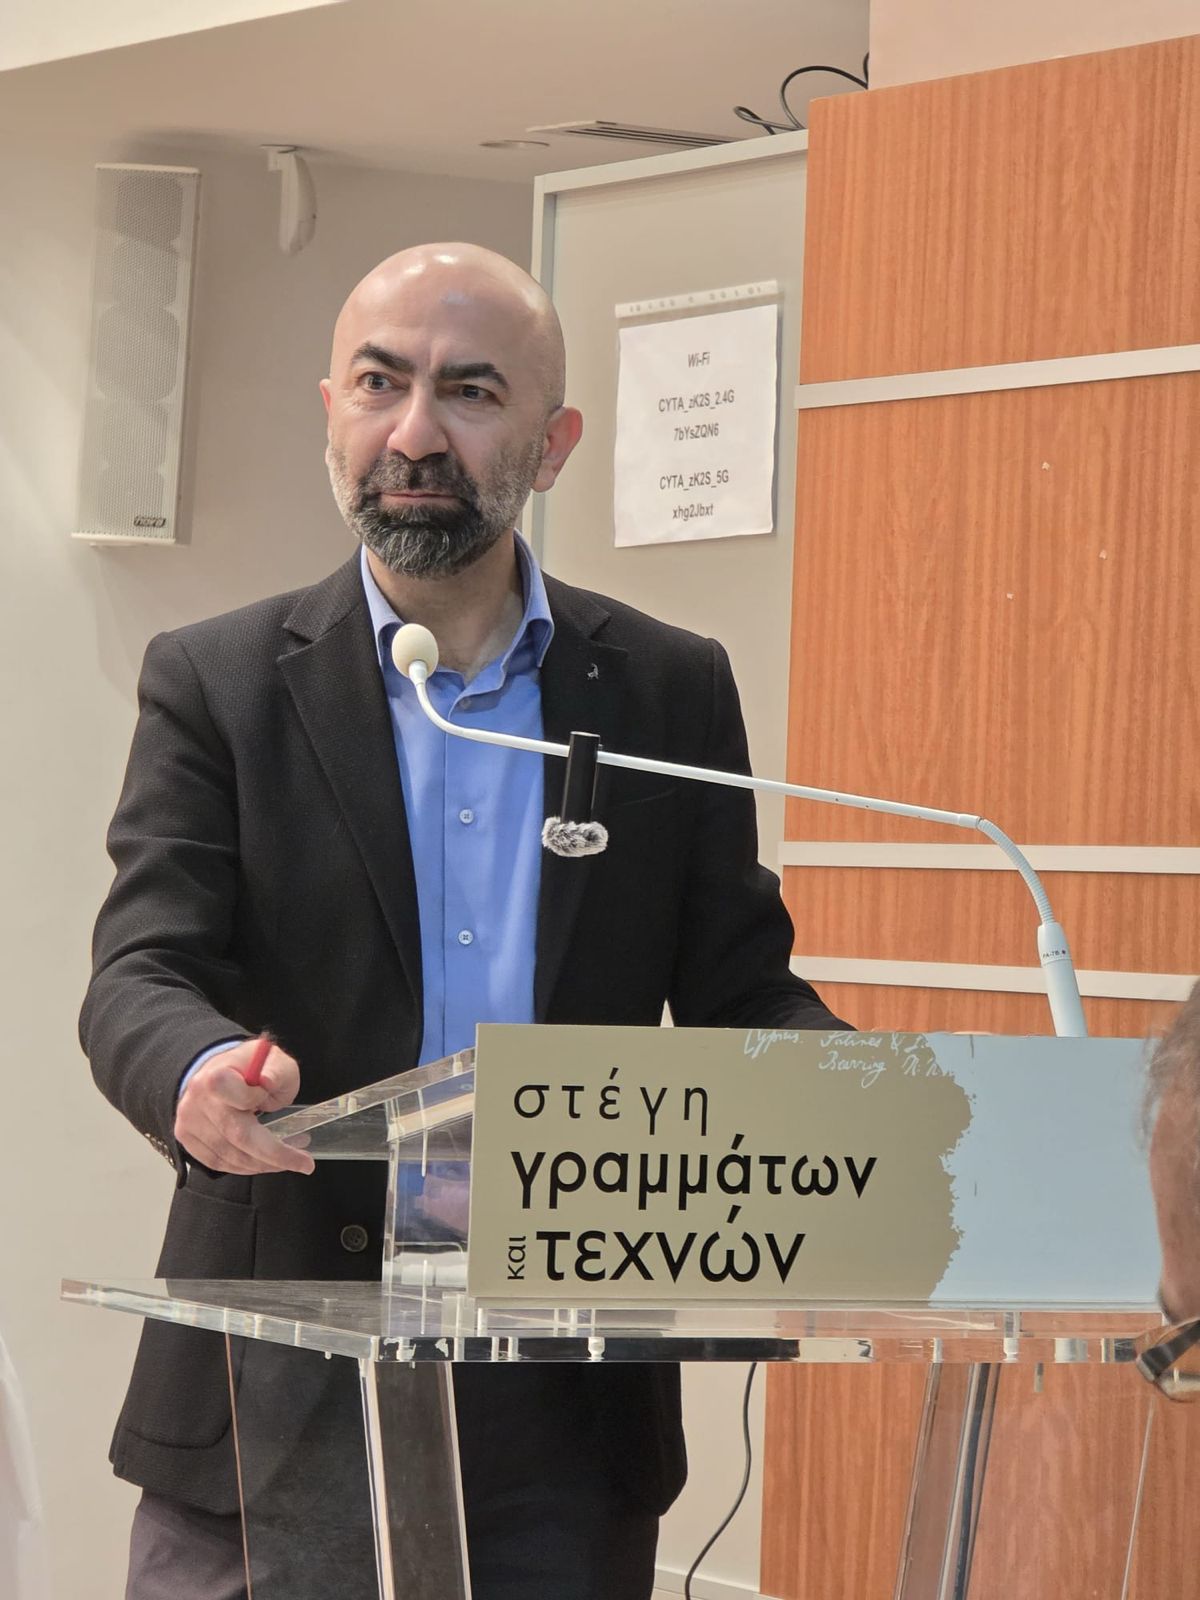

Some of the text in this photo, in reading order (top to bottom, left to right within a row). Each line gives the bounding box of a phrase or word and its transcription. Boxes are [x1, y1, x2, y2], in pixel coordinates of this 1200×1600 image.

[687, 351, 711, 368] Wi-Fi
[658, 389, 735, 413] CYTA_zK2S_2.4G
[659, 469, 729, 491] CYTA_zK2S_5G
[513, 1067, 708, 1136] στέγη
[510, 1133, 878, 1211] γραμμάτων
[507, 1204, 806, 1284] και τεχνών
